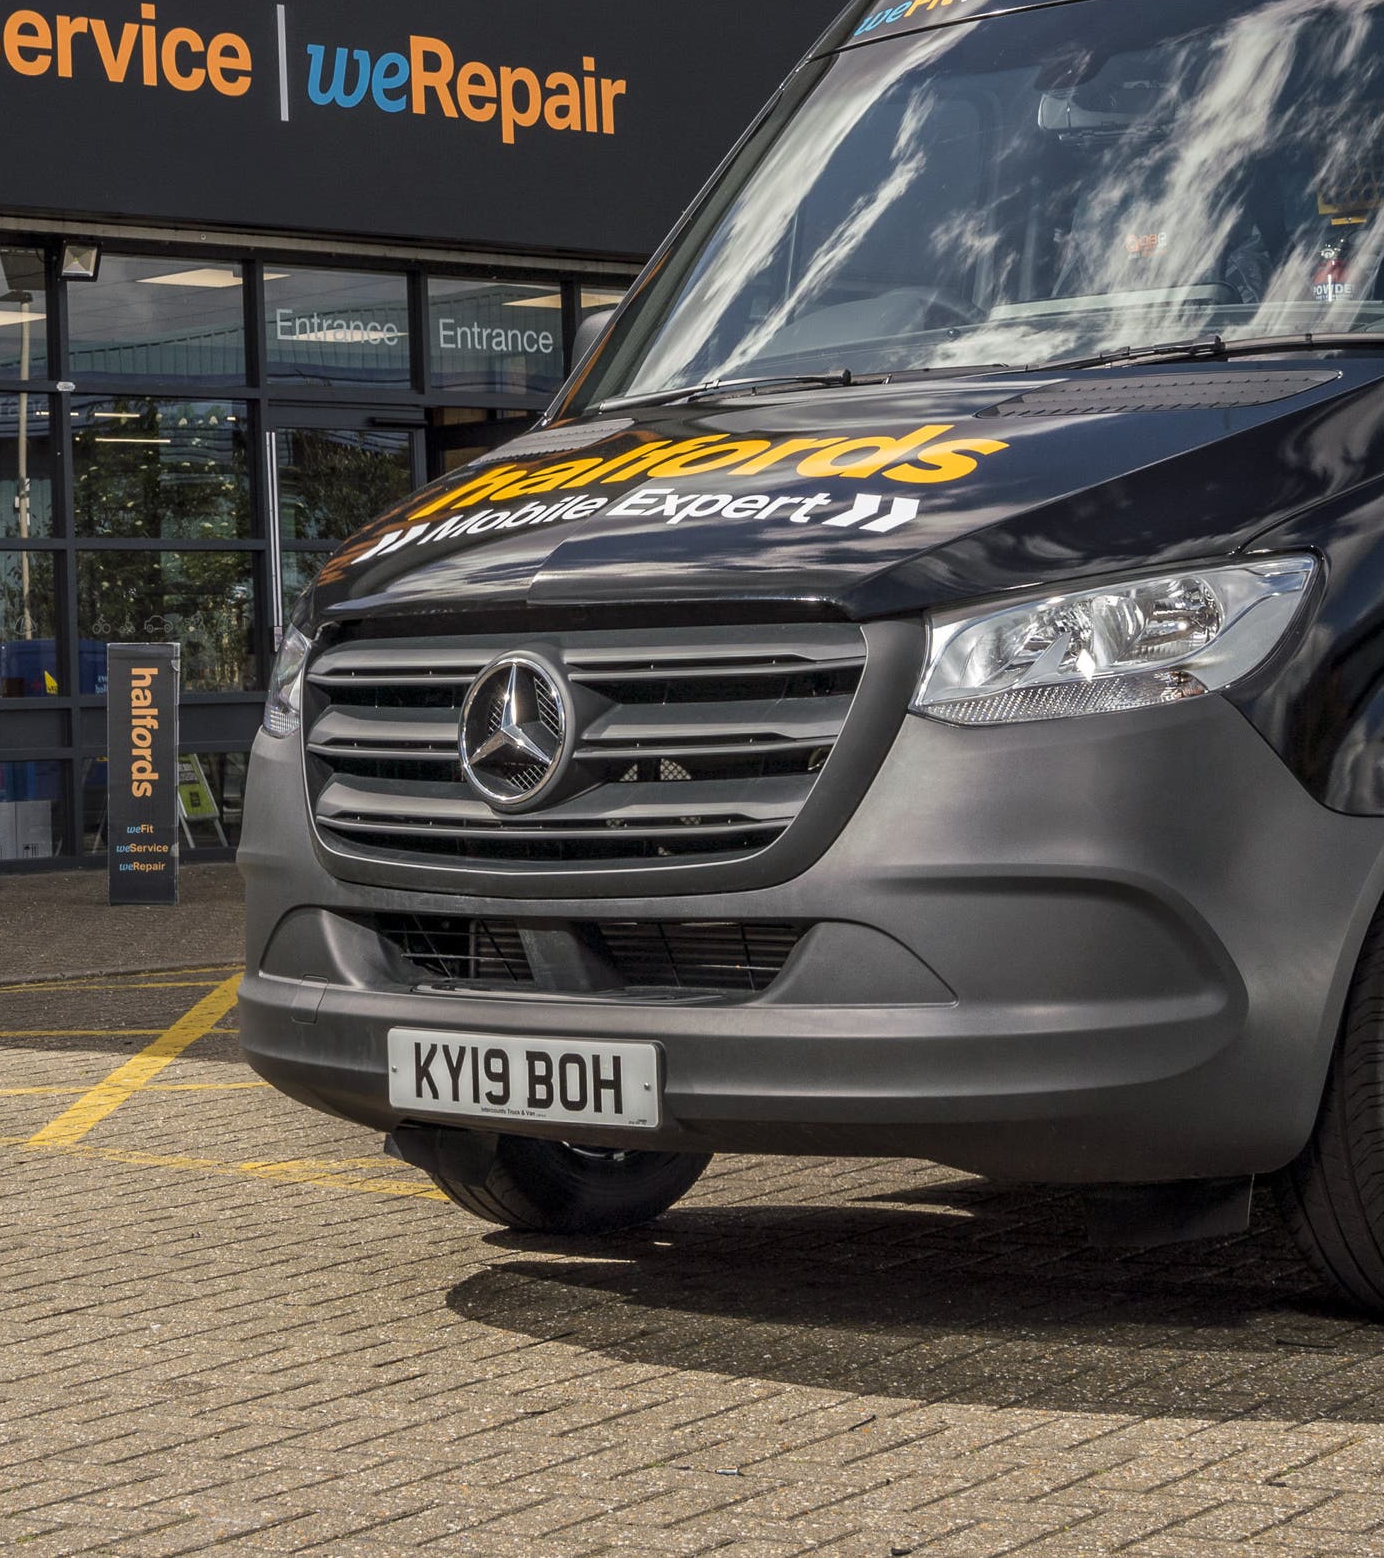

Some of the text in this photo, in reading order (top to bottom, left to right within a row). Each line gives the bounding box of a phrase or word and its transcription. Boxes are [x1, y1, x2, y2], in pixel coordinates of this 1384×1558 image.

[306, 35, 626, 145] weRepair
[1313, 284, 1352, 295] OWDE
[276, 308, 399, 346] Entrance
[439, 318, 554, 354] Entrance
[408, 425, 1009, 521] halfords
[417, 488, 832, 545] Mobile Expert
[131, 667, 159, 798] halfords
[126, 824, 154, 834] weFit
[116, 843, 169, 854] weService
[119, 861, 165, 872] weRepair
[414, 1042, 624, 1115] KY19 BOH
